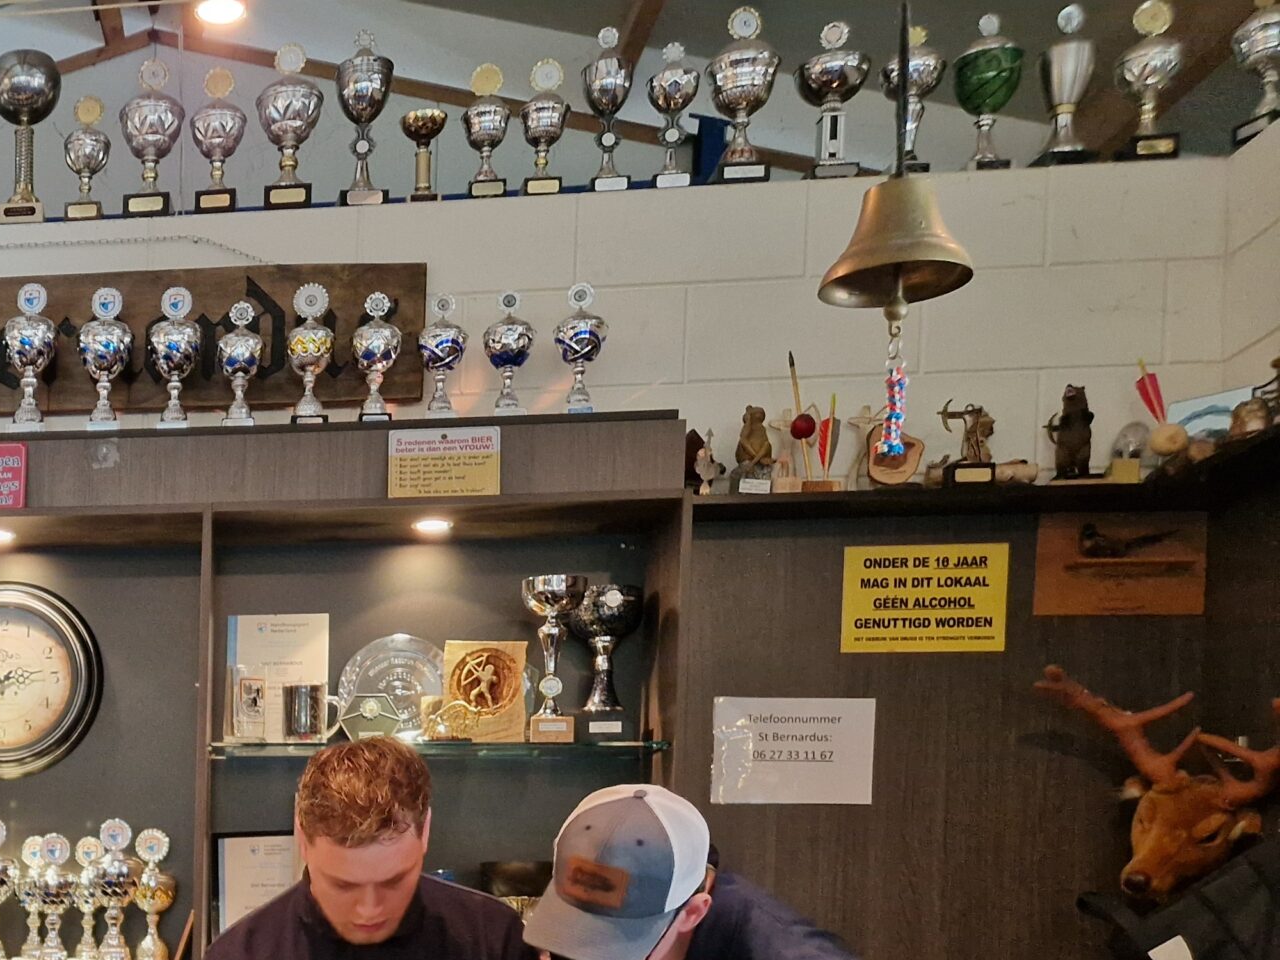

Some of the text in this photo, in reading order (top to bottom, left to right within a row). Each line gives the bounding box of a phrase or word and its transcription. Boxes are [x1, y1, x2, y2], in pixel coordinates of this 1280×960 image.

[396, 438, 402, 446] 5
[439, 437, 469, 445] waarom
[471, 435, 493, 443] BIER
[863, 557, 909, 569] ONDER
[913, 557, 930, 568] DE
[953, 556, 988, 568] JAAR
[860, 576, 990, 589] MAG IN DIT LOKAAL
[873, 595, 976, 609] GÉÉN ALCOHOL
[854, 616, 993, 630] GENUTTIGD WORDEN
[26, 628, 31, 638] 1
[42, 647, 53, 660] 2
[50, 671, 60, 684] 3
[40, 696, 50, 710] 4
[747, 714, 842, 724] Telefoonnummer
[24, 720, 32, 732] 5
[758, 732, 833, 742] St Bernardus:
[752, 750, 834, 760] 06 27 33 11 67
